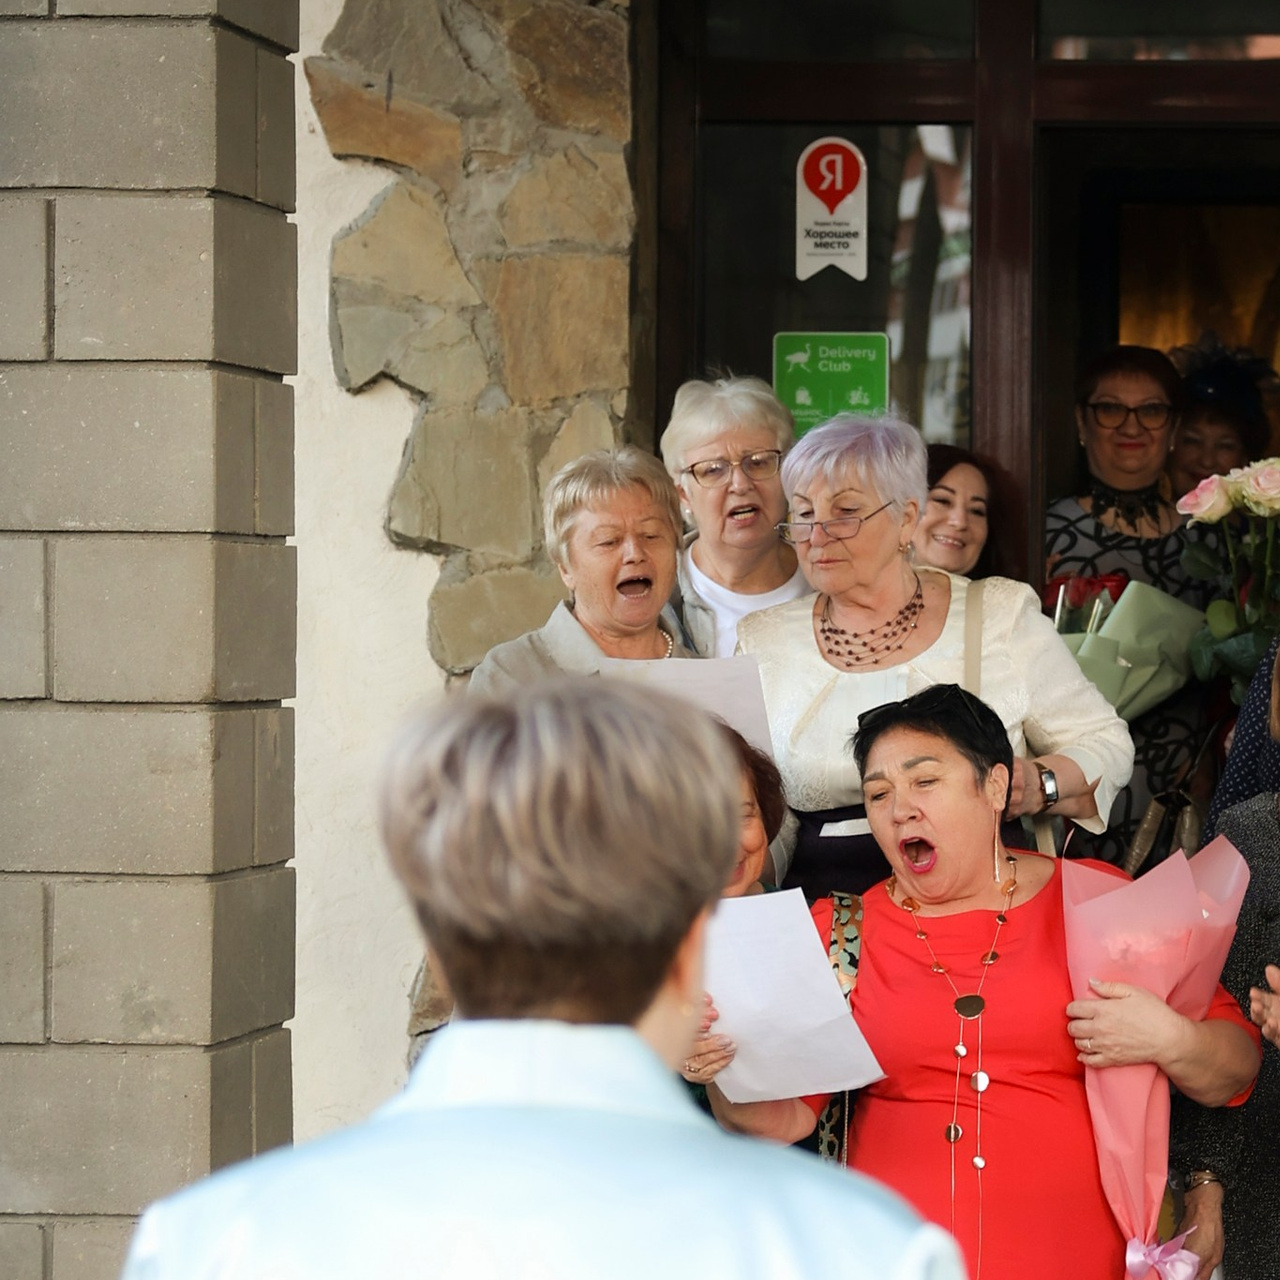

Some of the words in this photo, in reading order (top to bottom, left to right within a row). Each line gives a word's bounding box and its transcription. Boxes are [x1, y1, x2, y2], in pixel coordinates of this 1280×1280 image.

[819, 154, 843, 190] Я
[804, 229, 859, 239] Хорошее
[814, 241, 850, 249] место
[818, 346, 876, 361] Delivery
[818, 360, 851, 372] Club
